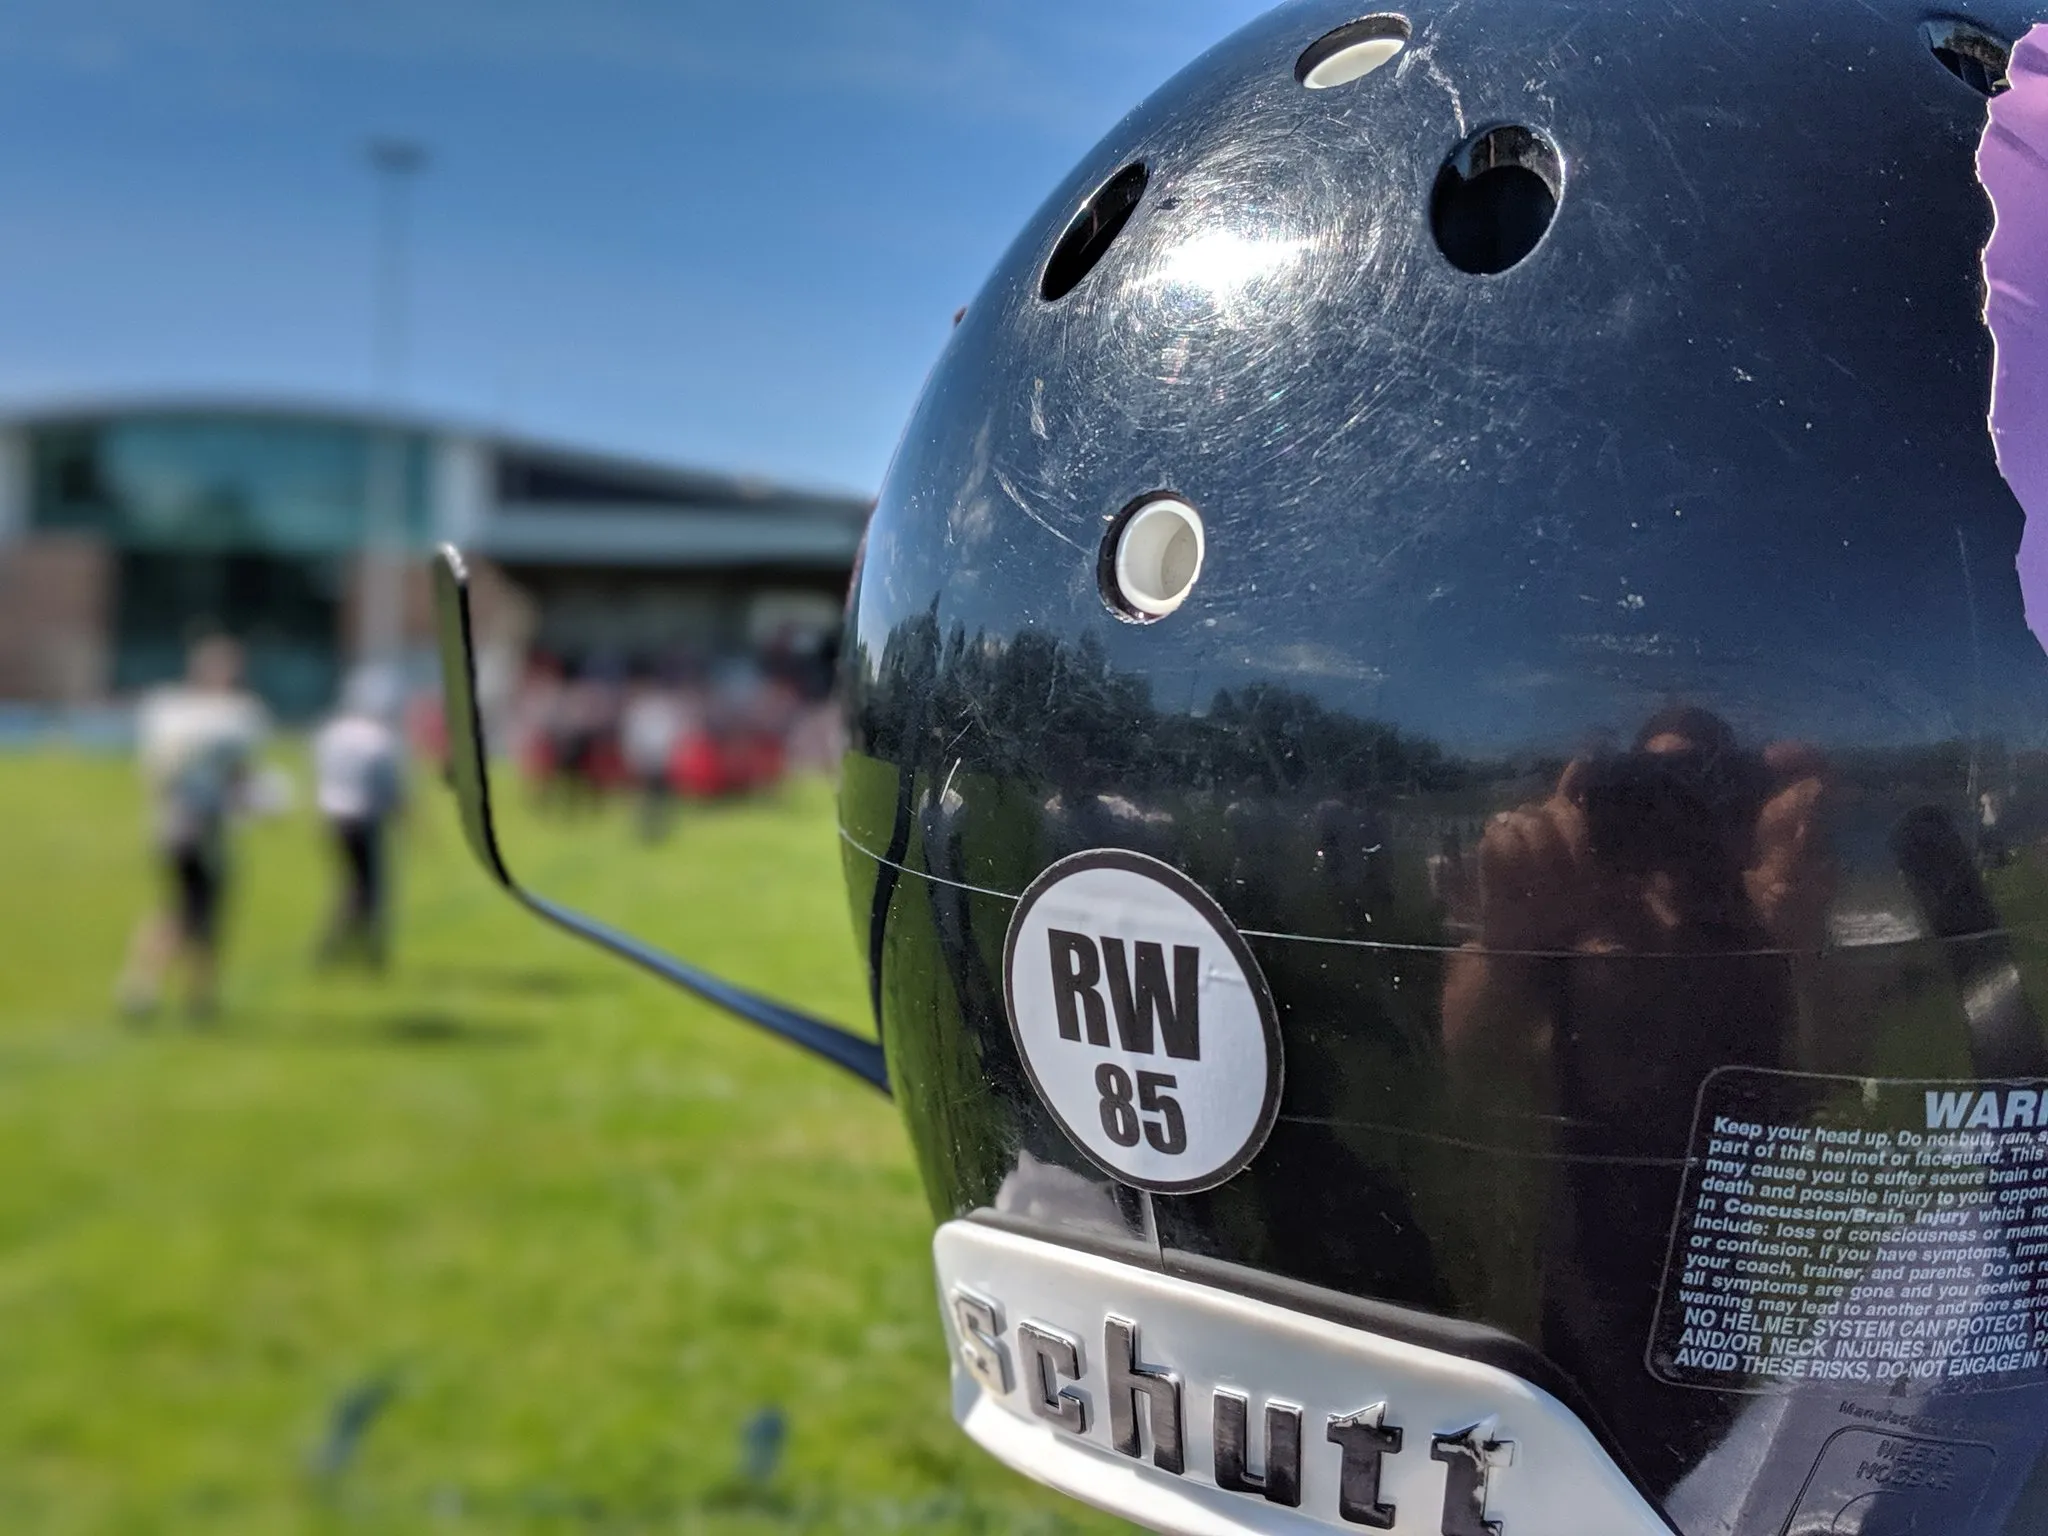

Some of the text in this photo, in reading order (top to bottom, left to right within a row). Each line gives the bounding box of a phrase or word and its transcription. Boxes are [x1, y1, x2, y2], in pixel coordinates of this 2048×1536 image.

[1048, 928, 1200, 1061] RW
[1095, 1063, 1187, 1155] 85
[1714, 1116, 1763, 1139] Keep
[1767, 1125, 1811, 1141] your
[1815, 1126, 1861, 1144] head
[1865, 1133, 1891, 1148] up.
[1897, 1131, 1921, 1146] Do
[1927, 1132, 1955, 1146] not
[1959, 1131, 1995, 1147] butt,
[2000, 1132, 2033, 1144] ram,
[1709, 1140, 2044, 1168] part of this helmet or faceguard. This
[1706, 1159, 1747, 1177] may
[1751, 1164, 1807, 1180] cause
[1811, 1169, 1846, 1185] you
[1851, 1170, 1868, 1182] to
[1874, 1170, 1925, 1185] suffer
[1929, 1171, 1985, 1185] severe
[1989, 1167, 2028, 1183] brain
[1702, 1176, 1755, 1196] death
[1760, 1184, 1796, 1199] and
[1800, 1188, 1878, 1203] possible
[1937, 1191, 1954, 1205] to
[1959, 1190, 1996, 1207] your
[1697, 1194, 1716, 1211] in
[1724, 1198, 1905, 1223] Concussion/Brain
[1914, 1209, 1970, 1226] Injury
[1979, 1205, 2025, 1222] which
[1694, 1213, 1769, 1236] include:
[1776, 1223, 1816, 1240] loss
[1822, 1226, 1843, 1241] of
[1849, 1229, 1976, 1243] consciousness
[1982, 1228, 2001, 1240] or
[1690, 1235, 1712, 1248] or
[1715, 1237, 1812, 1259] confusion.
[1819, 1245, 1835, 1259] If
[1836, 1248, 1870, 1263] you
[1875, 1247, 1917, 1261] have
[1922, 1246, 2010, 1263] symptoms,
[1685, 1252, 1730, 1268] your
[1735, 1258, 1796, 1278] coach,
[1802, 1263, 1865, 1281] trainer,
[1871, 1267, 1906, 1280] and
[1909, 1266, 1975, 1282] parents.
[1982, 1262, 2003, 1278] Do
[2008, 1260, 2035, 1275] not
[1682, 1271, 1706, 1286] all
[1711, 1275, 1808, 1294] symptoms
[1814, 1283, 1844, 1297] are
[1850, 1286, 1895, 1300] gone
[1900, 1284, 1933, 1298] and
[1938, 1284, 1969, 1300] you
[1974, 1279, 2031, 1295] receive
[1679, 1289, 1753, 1312] warning
[1758, 1299, 1798, 1315] may
[1801, 1300, 1839, 1315] lead
[1843, 1301, 1861, 1316] to
[1864, 1301, 1932, 1316] another
[1935, 1300, 1967, 1316] and
[1969, 1300, 2010, 1312] more
[1684, 1307, 1717, 1328] NO
[1721, 1311, 1808, 1335] HELMET
[1812, 1318, 1895, 1338] SYSTEM
[1900, 1319, 1943, 1337] CAN
[1944, 1312, 2031, 1336] PROTECT
[1678, 1328, 1763, 1352] AND/OR
[1770, 1337, 1830, 1356] NECK
[1834, 1340, 1925, 1359] INJURIES
[1930, 1332, 2028, 1357] INCLUDING
[1674, 1347, 1738, 1371] AVOID
[1741, 1355, 1809, 1378] THESE
[1809, 1360, 1872, 1382] RISKS,
[1876, 1361, 1906, 1378] DO
[1908, 1360, 1947, 1378] NOT
[1948, 1352, 2024, 1376] ENGAGE
[2021, 1351, 2040, 1368] IN
